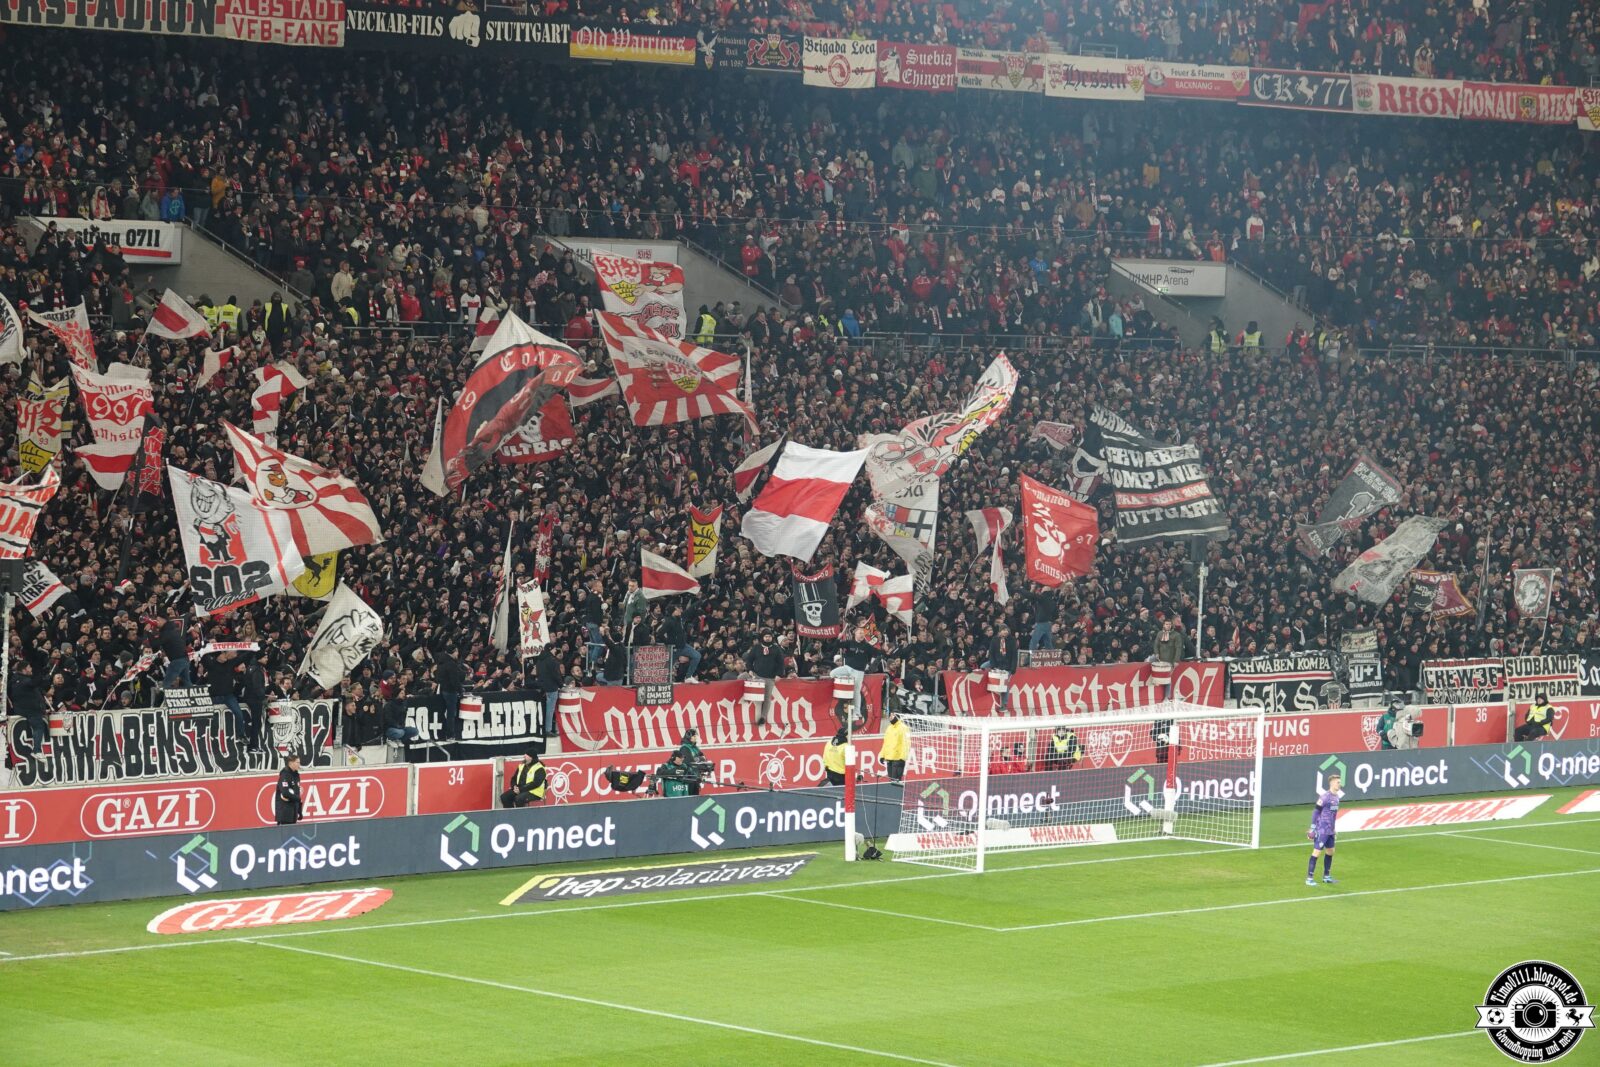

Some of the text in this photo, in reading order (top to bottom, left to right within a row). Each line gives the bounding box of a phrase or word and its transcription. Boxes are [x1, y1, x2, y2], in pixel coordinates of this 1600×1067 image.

[229, 0, 344, 20] ALBSTADT
[232, 16, 339, 45] VFB-FANS
[346, 9, 571, 44] NECKAR-FILS STUTTGART
[576, 25, 686, 56] Old Warriors
[804, 38, 876, 56] Brigada Loca
[906, 48, 952, 67] Suebia
[902, 68, 955, 88] Ehingen
[1063, 63, 1127, 91] Hessen
[1170, 68, 1225, 79] Feuer & Flamme
[1175, 81, 1213, 90] BACKNANG
[1321, 78, 1350, 106] 77
[1377, 82, 1461, 116] RHÖN
[1463, 88, 1517, 120] DONAU
[126, 229, 161, 247] 0711
[1163, 274, 1189, 286] Arena
[1229, 657, 1295, 674] SCHWABEN
[1505, 655, 1578, 676] SÜDBANDE
[1173, 666, 1219, 708] 97
[1424, 668, 1475, 690] CREW
[1508, 680, 1580, 699] STUTTGART
[164, 686, 210, 698] GEGEN ALLE
[166, 696, 213, 707] STADT- UND
[559, 684, 817, 752] Commando
[1475, 707, 1488, 723] 36
[301, 703, 333, 767] 02
[1188, 718, 1310, 742] VfB-STITUNG
[1188, 744, 1242, 762] Brustring
[1269, 741, 1309, 757] Herzen
[448, 767, 465, 786] 34
[1354, 758, 1448, 793] Q-nnect
[957, 784, 1061, 822] Qnnect
[1360, 798, 1517, 830] WINAMAX
[735, 801, 845, 839] Q-nnect
[490, 816, 615, 859] Q-nnect
[1029, 824, 1095, 844] WINAMAX
[230, 836, 360, 881] Q-nnect
[544, 859, 806, 899] hep solarinvest
